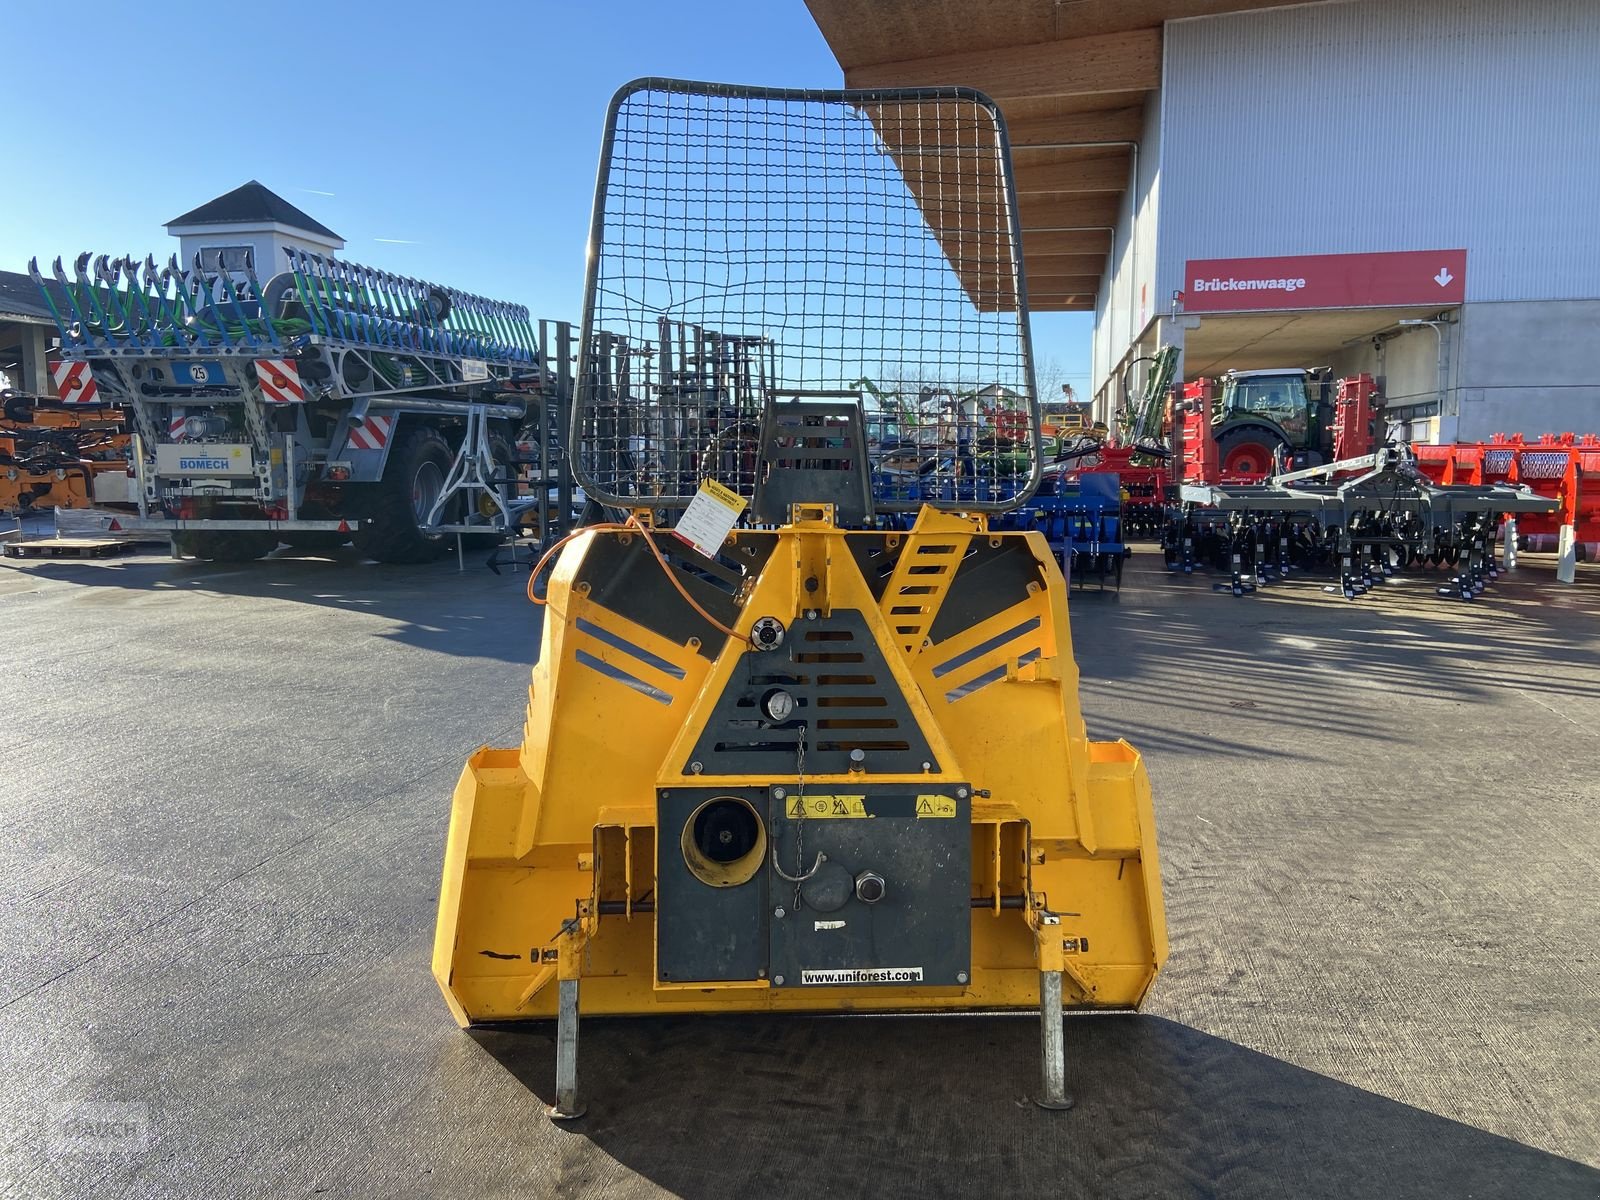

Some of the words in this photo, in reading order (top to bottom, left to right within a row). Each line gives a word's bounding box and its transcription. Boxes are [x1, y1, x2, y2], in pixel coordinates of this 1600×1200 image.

[1193, 278, 1306, 291] Brückenwaage
[192, 367, 206, 379] 25
[180, 460, 229, 469] BOMECH
[804, 970, 921, 983] www.uniforest.com
